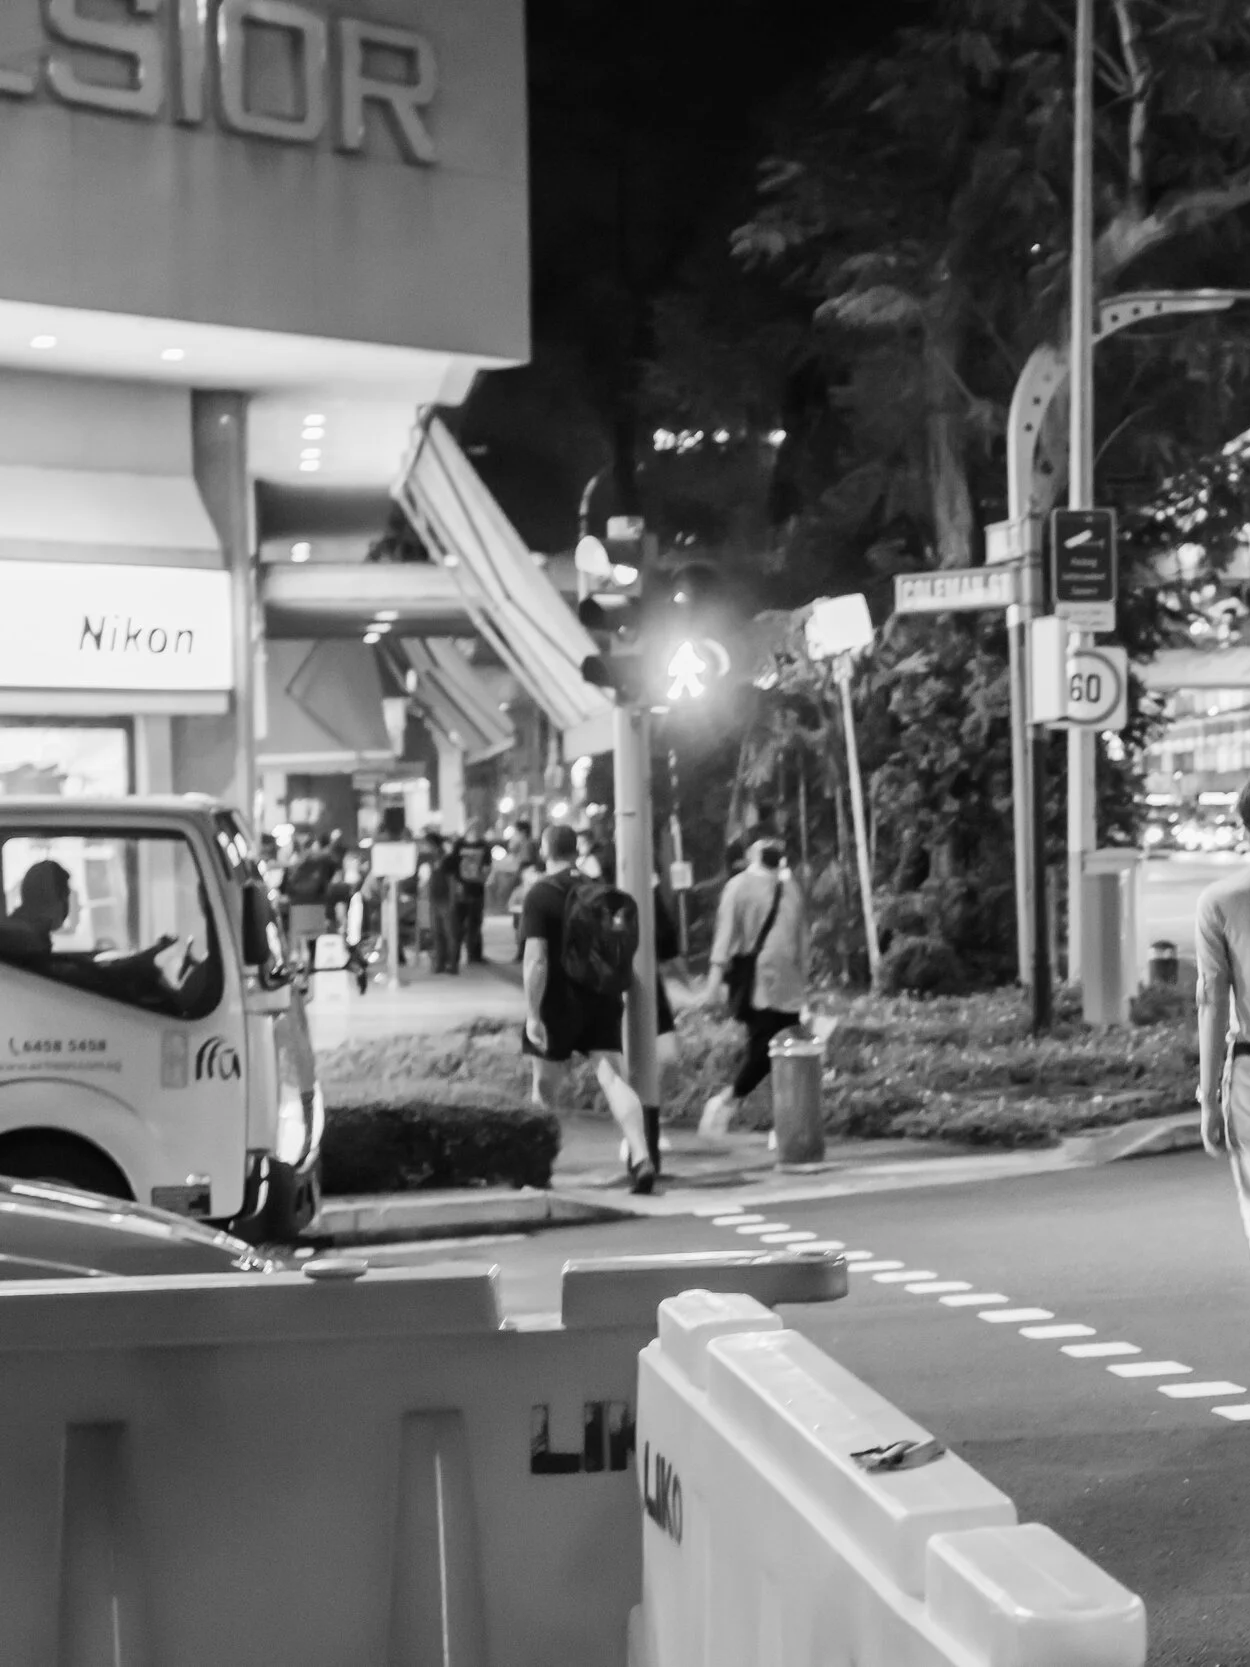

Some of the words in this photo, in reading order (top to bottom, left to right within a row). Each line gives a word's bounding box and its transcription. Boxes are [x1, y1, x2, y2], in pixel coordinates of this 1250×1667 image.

[0, 0, 438, 164] SIOR
[79, 614, 195, 654] Nikon
[1069, 673, 1102, 703] 60
[644, 1440, 683, 1547] LIKO
